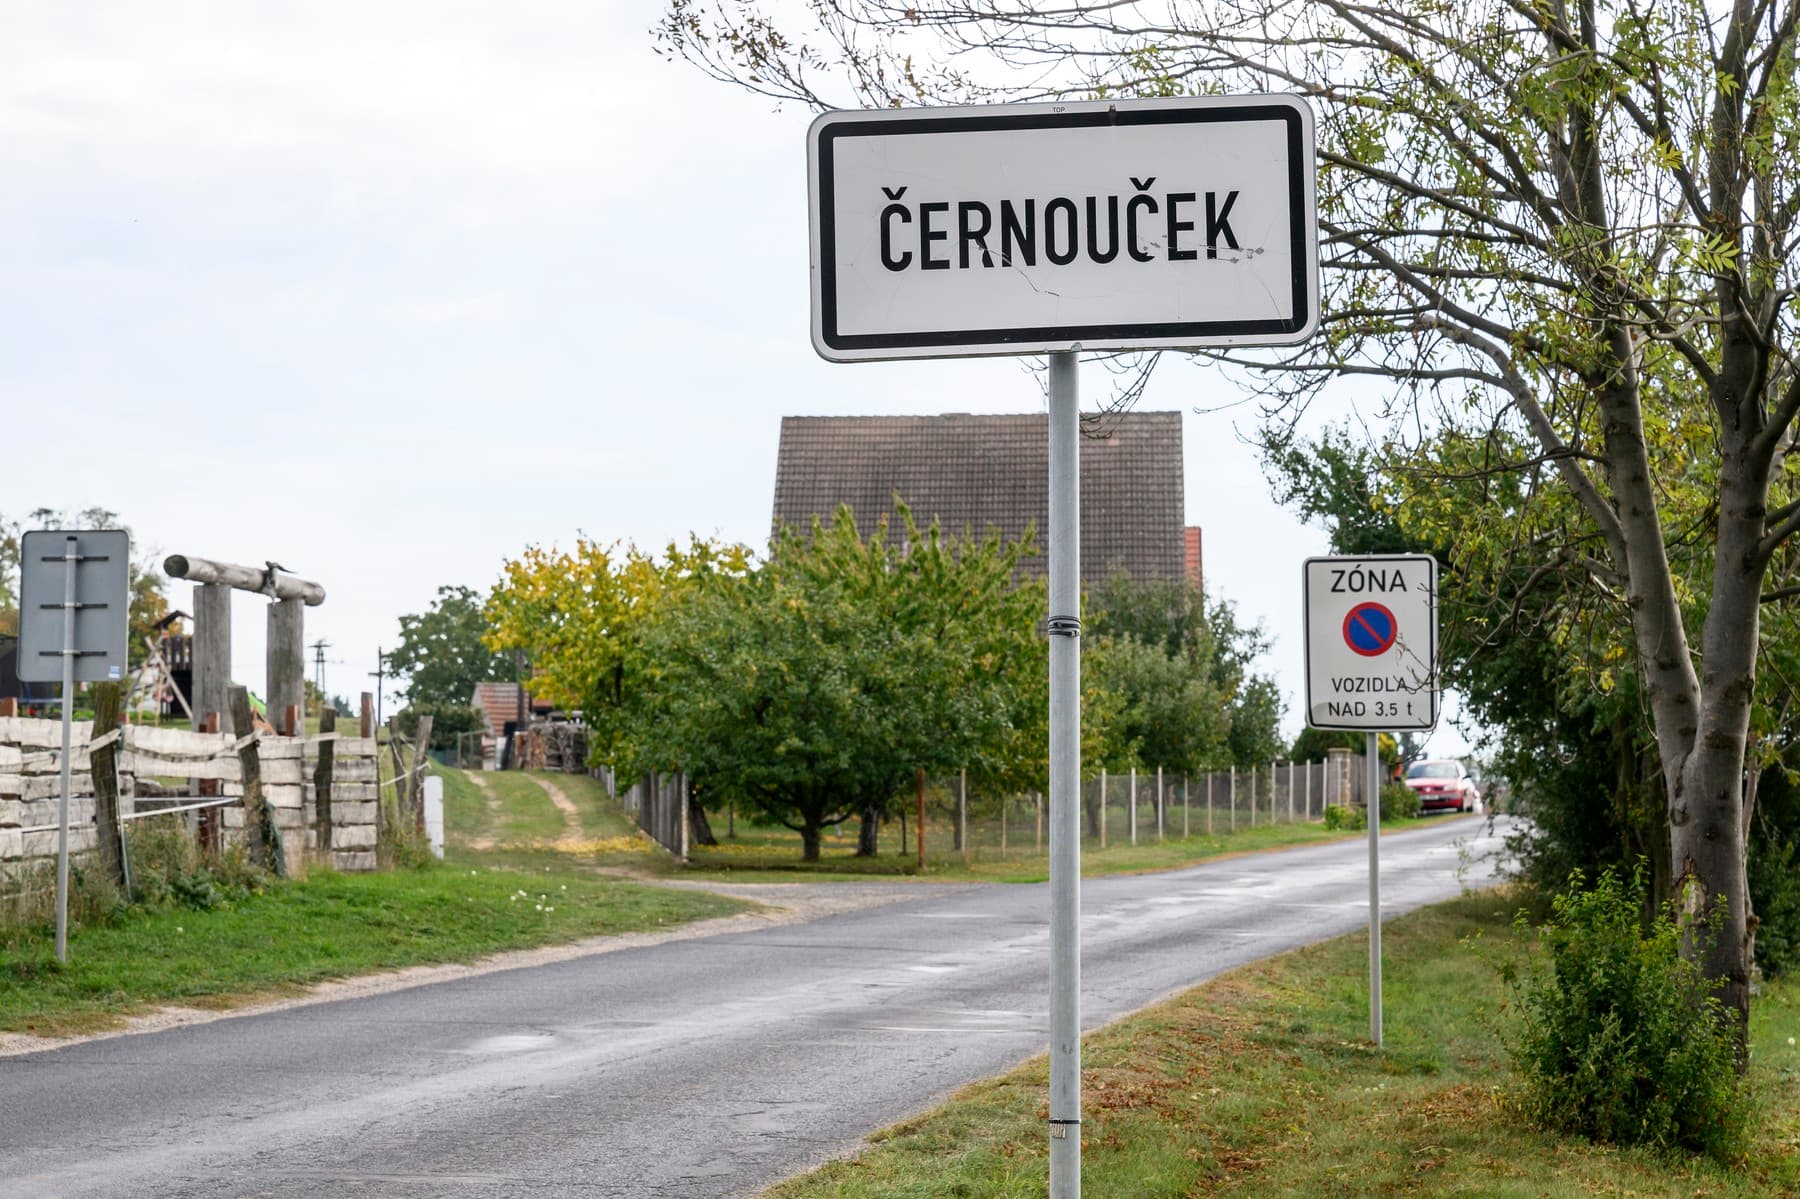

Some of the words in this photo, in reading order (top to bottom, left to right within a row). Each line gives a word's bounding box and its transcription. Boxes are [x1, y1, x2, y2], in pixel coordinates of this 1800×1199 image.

[880, 177, 1240, 272] ČERNOUČEK
[1331, 564, 1408, 593] ZÓNA
[1332, 677, 1408, 693] VOZIDLA
[1328, 701, 1366, 717] NAD
[1407, 701, 1413, 716] t
